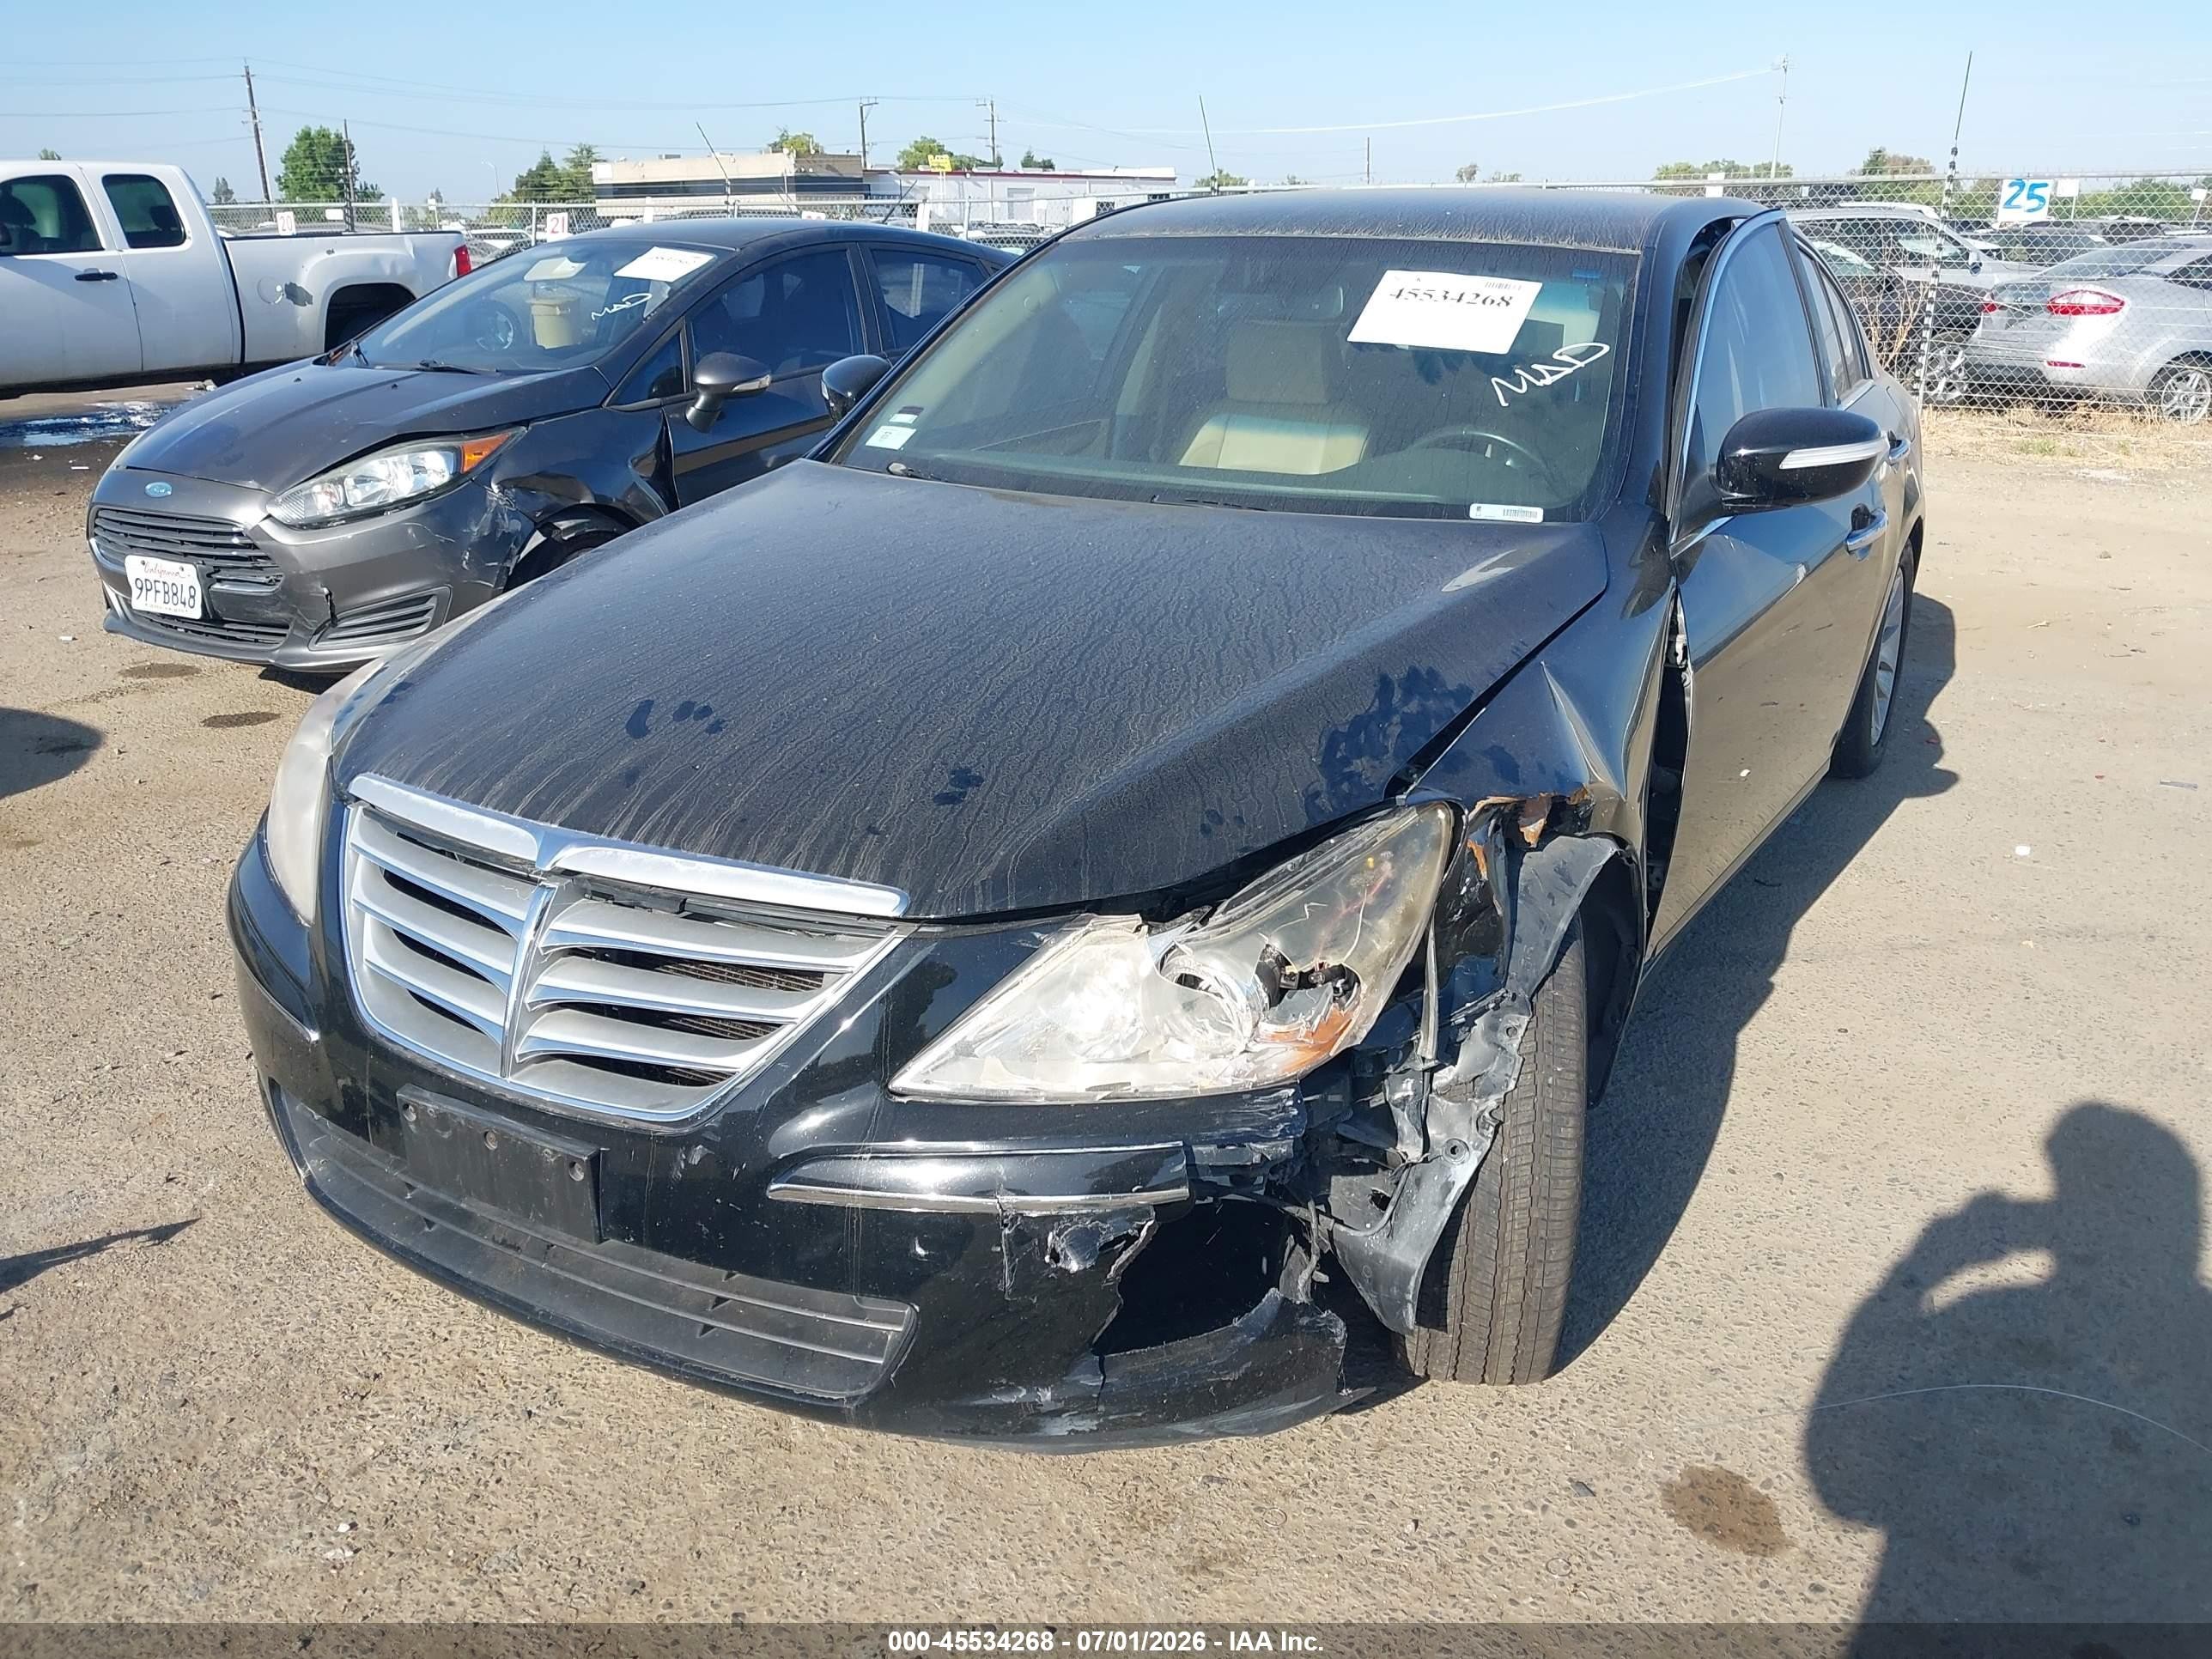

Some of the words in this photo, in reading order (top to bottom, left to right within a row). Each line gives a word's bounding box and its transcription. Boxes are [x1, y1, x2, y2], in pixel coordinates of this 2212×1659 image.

[2002, 179, 2049, 213] 25
[279, 215, 293, 232] 20
[550, 216, 565, 234] 21
[1389, 287, 1514, 307] 45534268
[143, 561, 185, 580] California
[135, 577, 197, 610] 9PFB848
